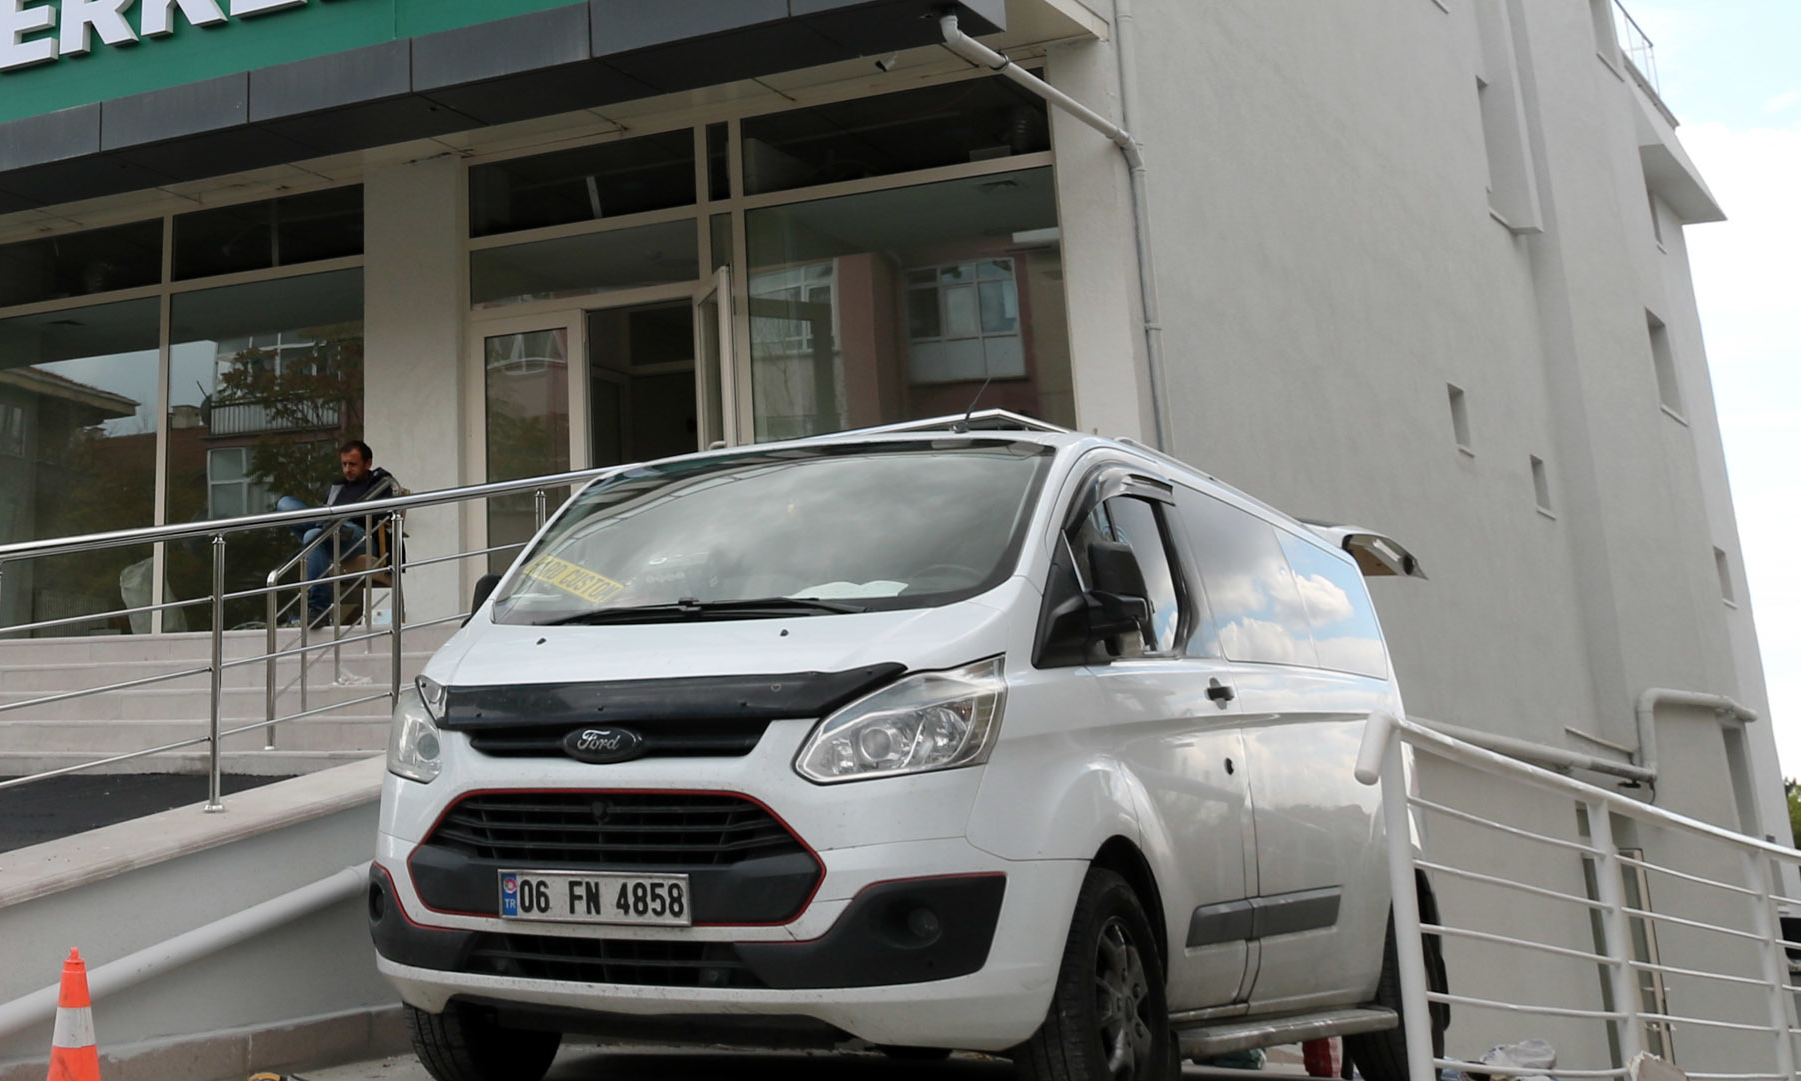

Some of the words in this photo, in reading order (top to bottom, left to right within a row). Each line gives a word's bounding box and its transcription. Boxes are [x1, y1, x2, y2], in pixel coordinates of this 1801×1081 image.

[577, 729, 620, 751] Ford
[505, 898, 516, 909] TR
[519, 879, 550, 914] 06
[568, 881, 601, 915] FN
[616, 882, 684, 918] 4858
